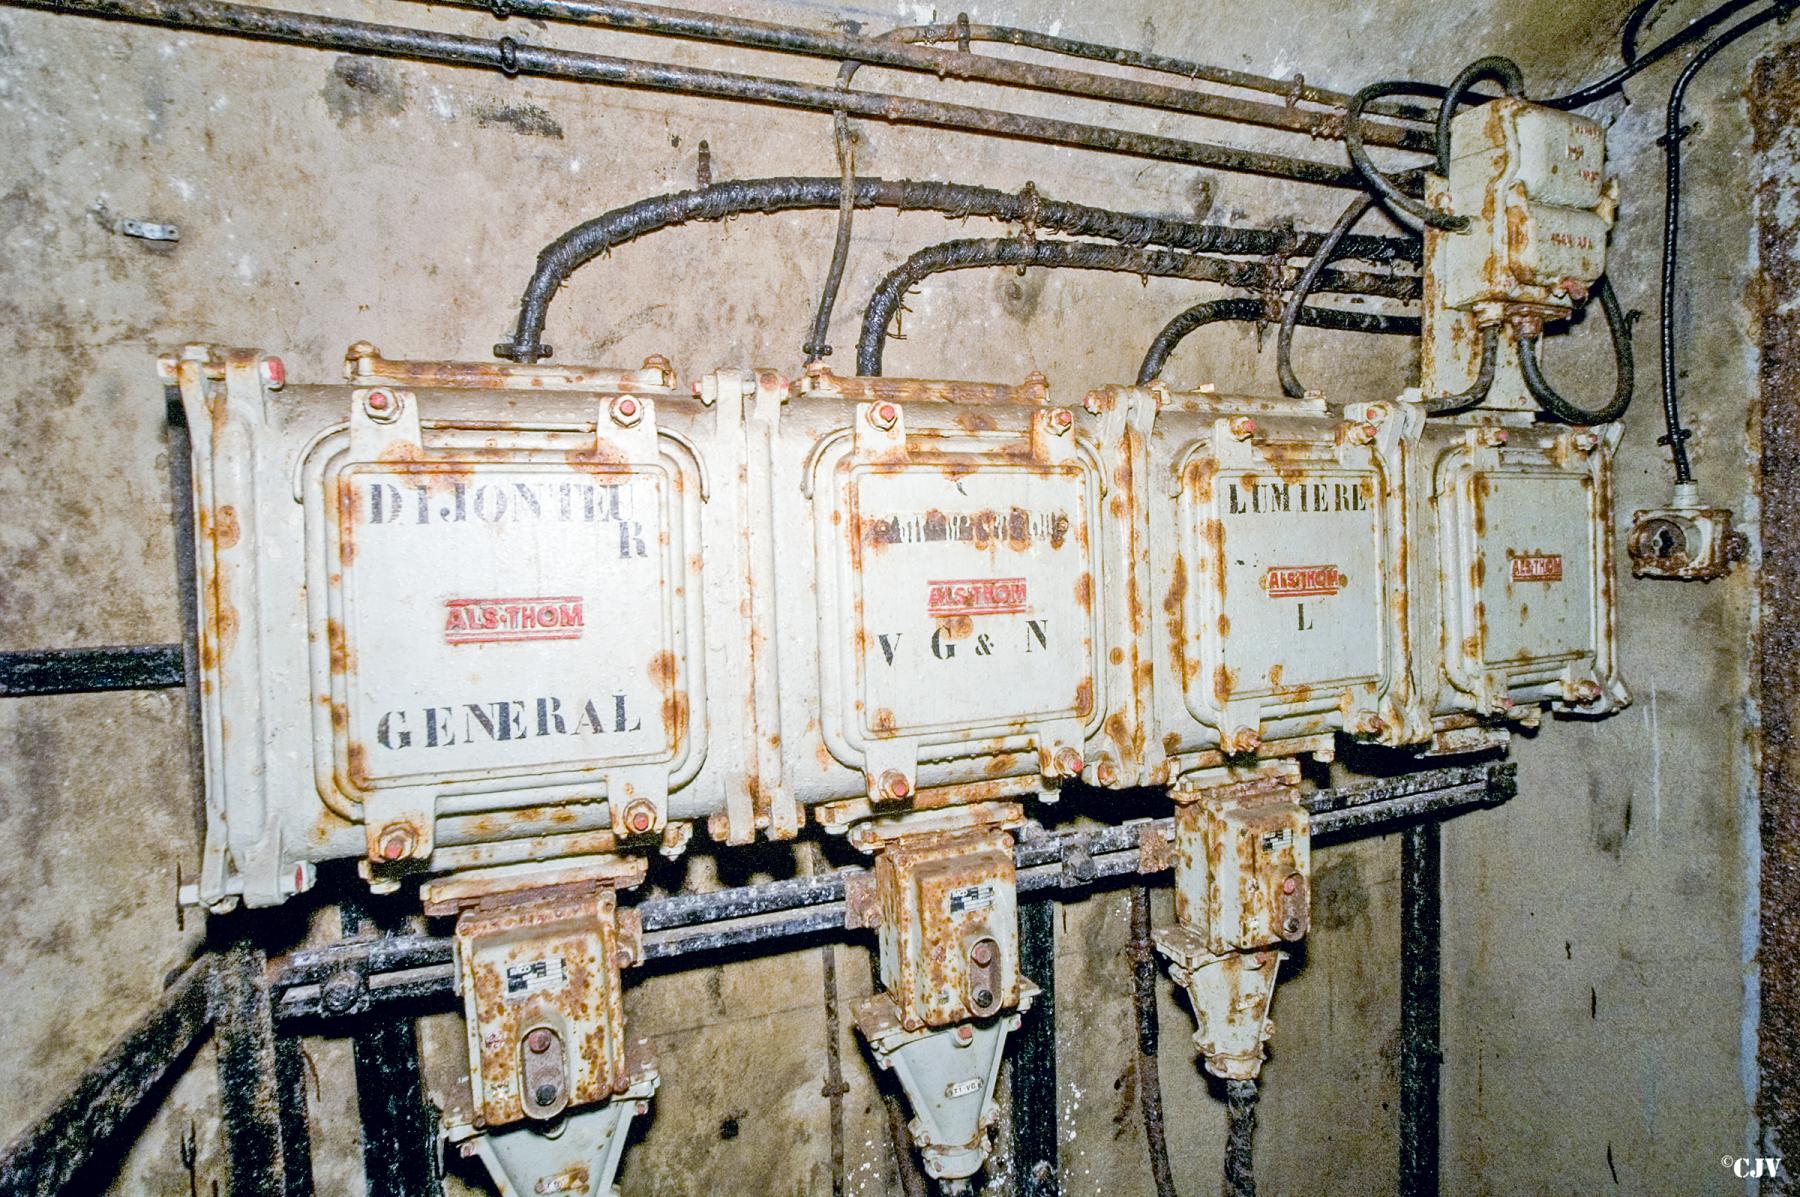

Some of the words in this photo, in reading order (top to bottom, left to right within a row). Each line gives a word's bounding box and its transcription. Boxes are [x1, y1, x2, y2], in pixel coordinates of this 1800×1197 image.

[1229, 484, 1366, 514] LUMIERE
[1297, 603, 1313, 630] L
[878, 633, 902, 666] V
[931, 626, 955, 659] G
[975, 633, 994, 656] &
[1026, 619, 1049, 653] N
[377, 694, 641, 750] GENERAL
